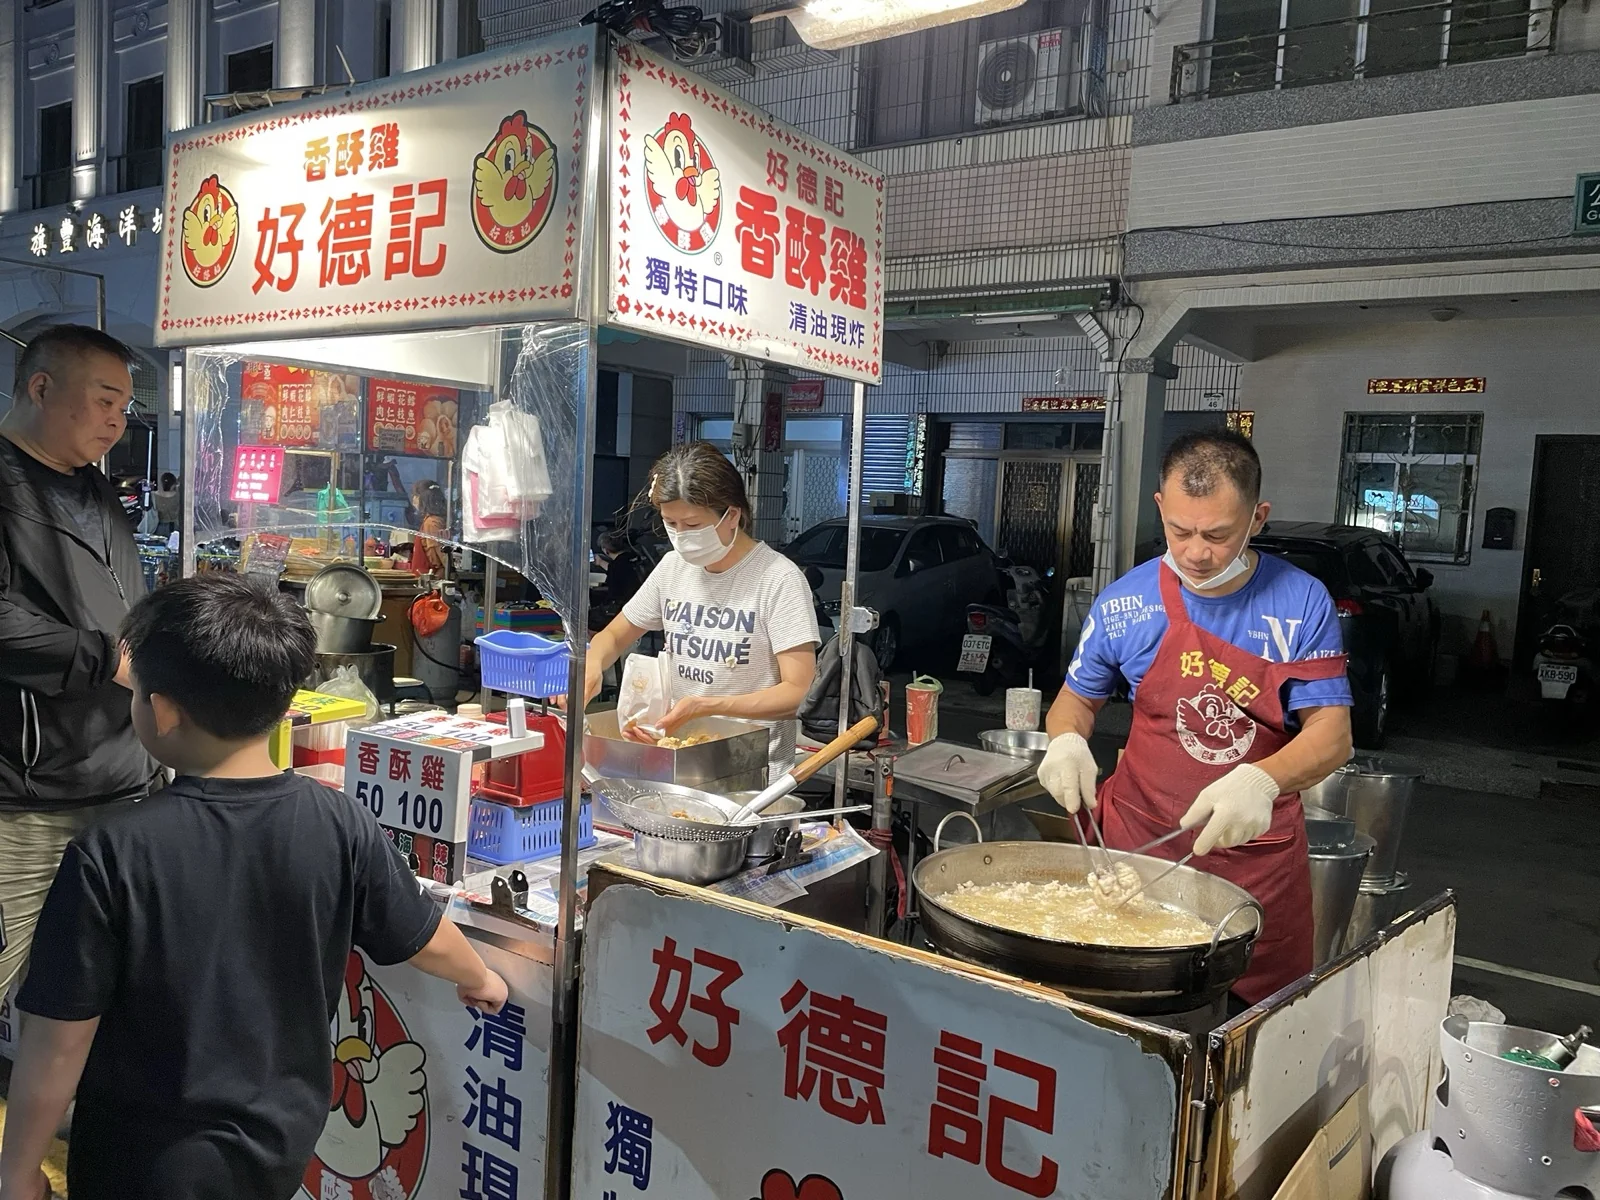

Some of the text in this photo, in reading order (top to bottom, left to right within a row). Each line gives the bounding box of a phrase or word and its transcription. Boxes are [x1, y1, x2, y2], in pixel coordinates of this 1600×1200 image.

[304, 121, 400, 182] 香酥雞
[766, 147, 845, 217] 好德記
[252, 178, 449, 295] 好德記
[735, 185, 868, 311] 香酥雞
[645, 256, 748, 317] 獨特口味
[789, 301, 865, 350] 清油現炸
[664, 599, 755, 634] MAISON
[1101, 595, 1143, 616] VBHN
[1248, 630, 1269, 640] VBHN
[678, 665, 714, 684] PARIS
[1180, 651, 1261, 708] 好德記
[358, 741, 445, 791] 香酥雞
[356, 781, 443, 833] 50 100
[646, 935, 1059, 1198] 好德記
[459, 999, 527, 1200] 清油現
[604, 1100, 653, 1200] 獨
